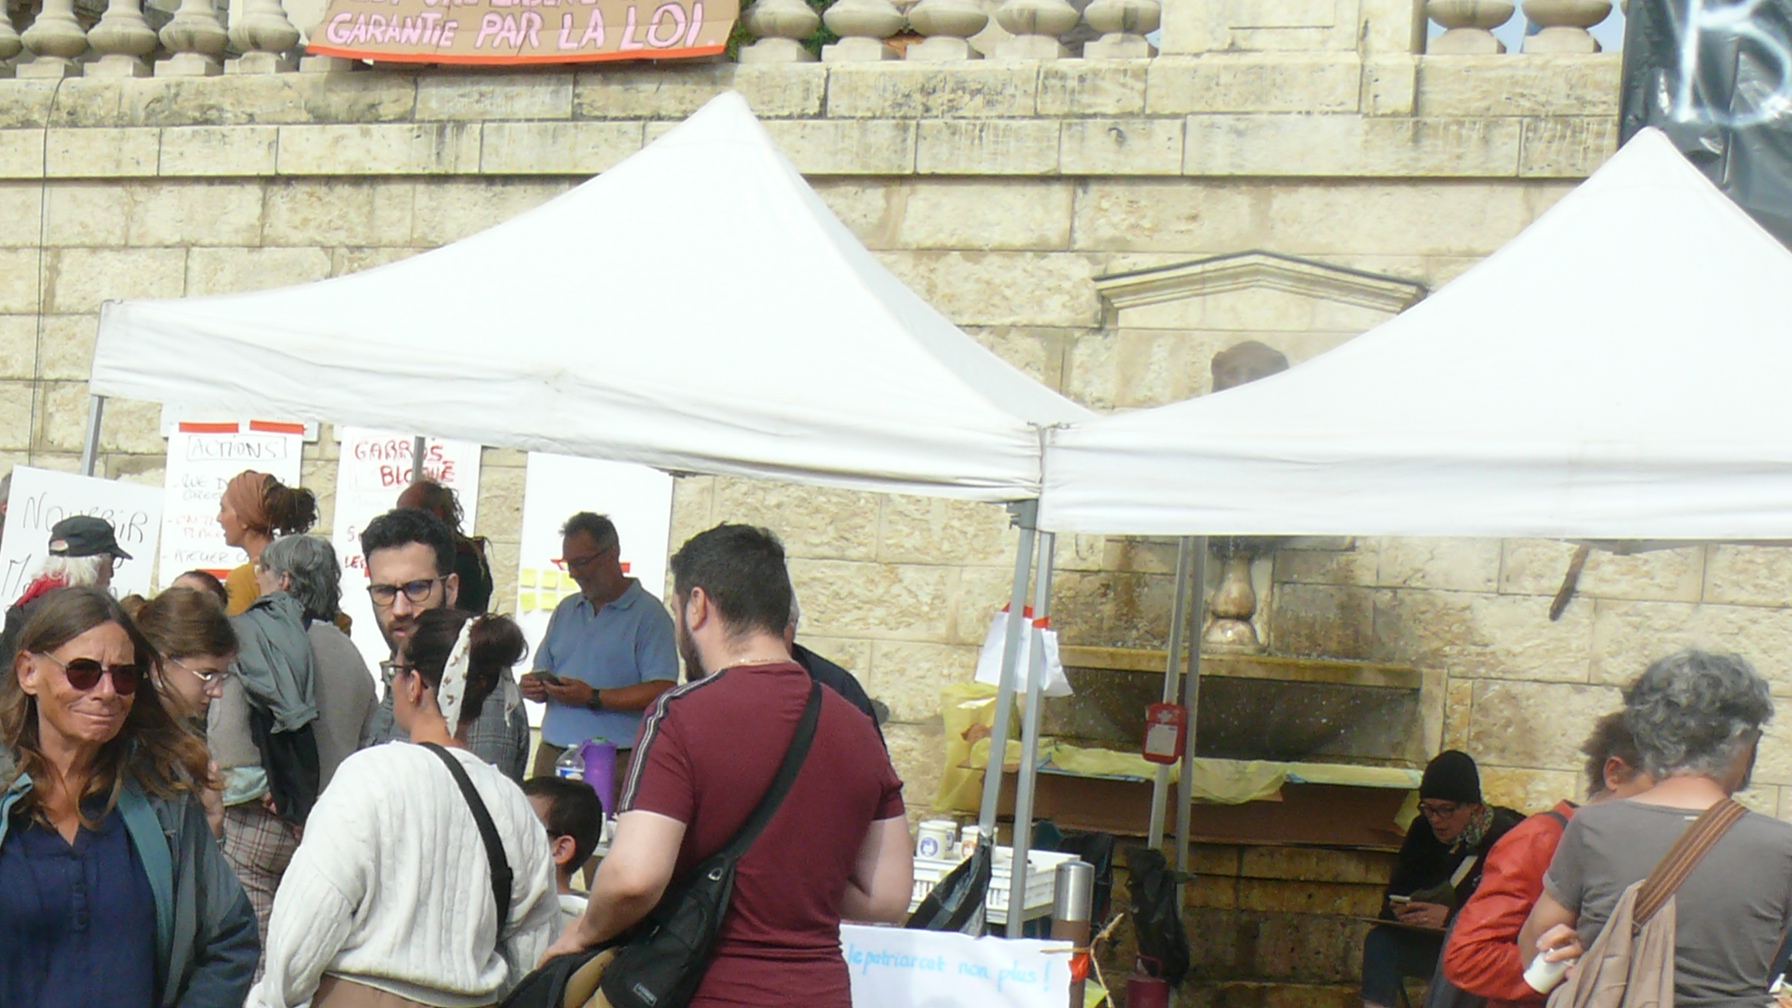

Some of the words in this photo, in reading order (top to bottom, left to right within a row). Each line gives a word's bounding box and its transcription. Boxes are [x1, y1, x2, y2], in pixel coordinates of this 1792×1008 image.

[326, 11, 458, 48] GARANTIE
[474, 11, 545, 49] PAR
[558, 7, 606, 51] LA
[191, 440, 280, 459] ACTIONS
[354, 439, 444, 463] GARRS
[958, 960, 991, 980] non
[998, 960, 1038, 993] plus
